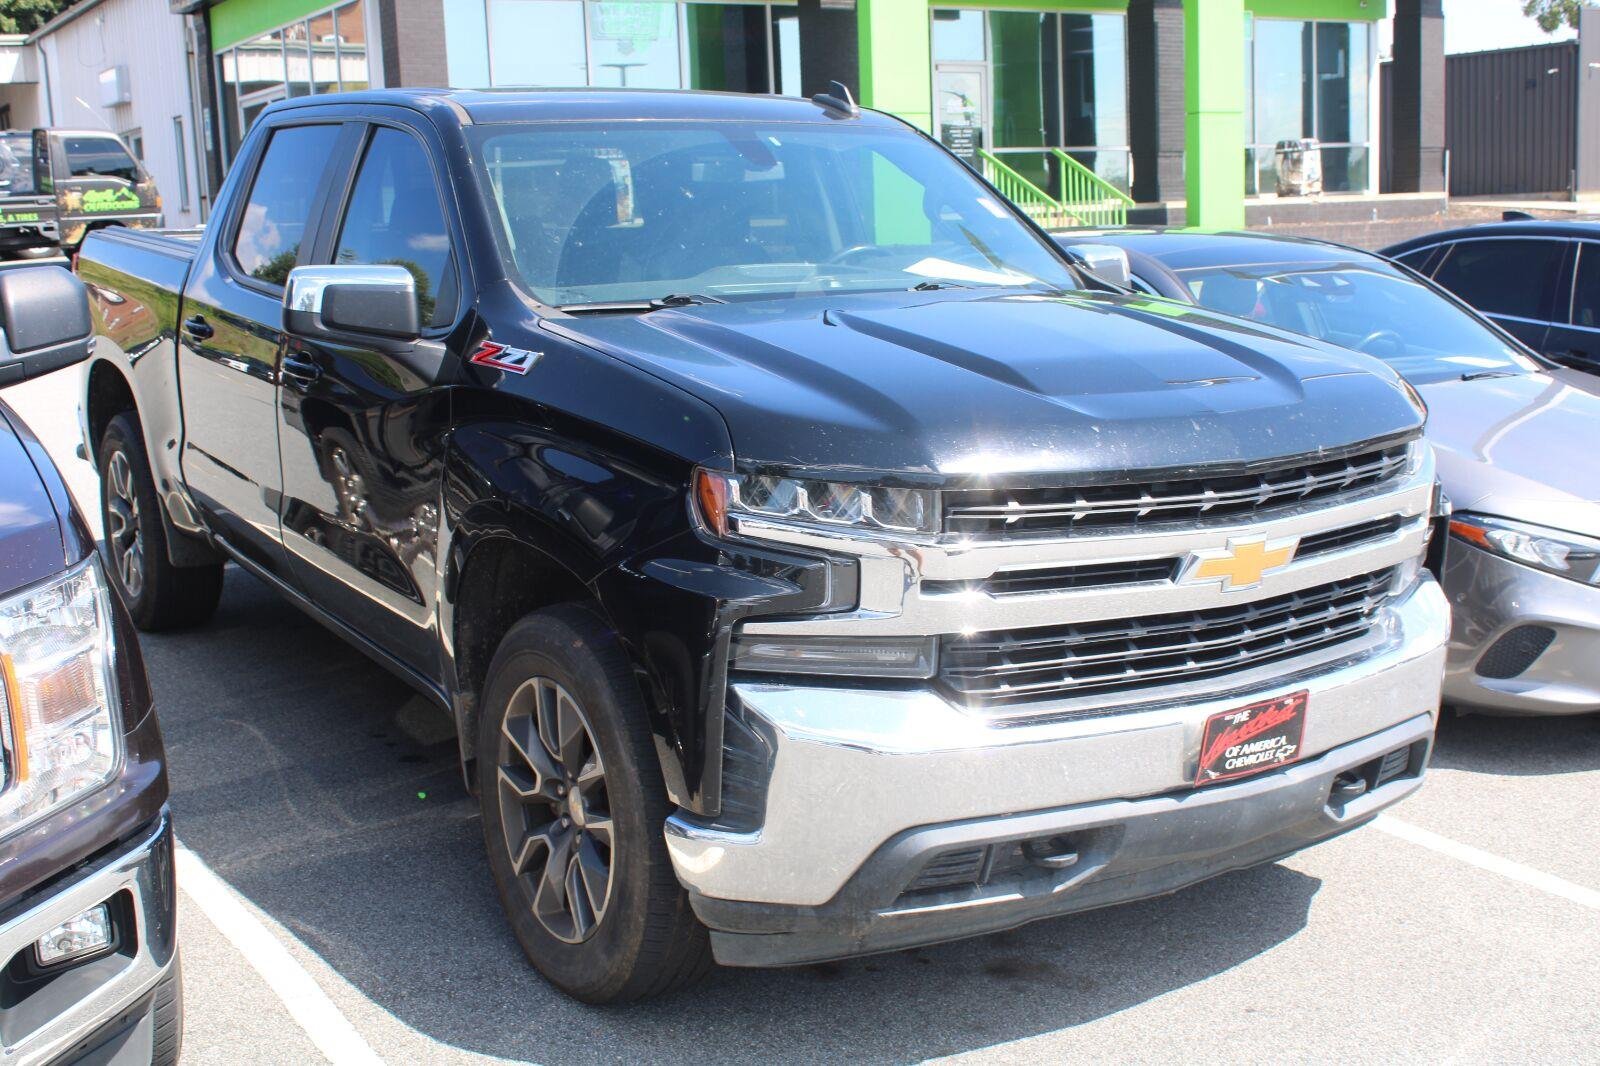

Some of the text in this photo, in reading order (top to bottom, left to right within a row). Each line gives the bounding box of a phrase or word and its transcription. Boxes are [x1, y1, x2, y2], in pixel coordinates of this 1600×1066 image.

[470, 339, 545, 376] Z71
[1232, 710, 1251, 724] THE
[1225, 736, 1287, 758] OF AMERICA
[1225, 750, 1276, 769] CHEVROLET
